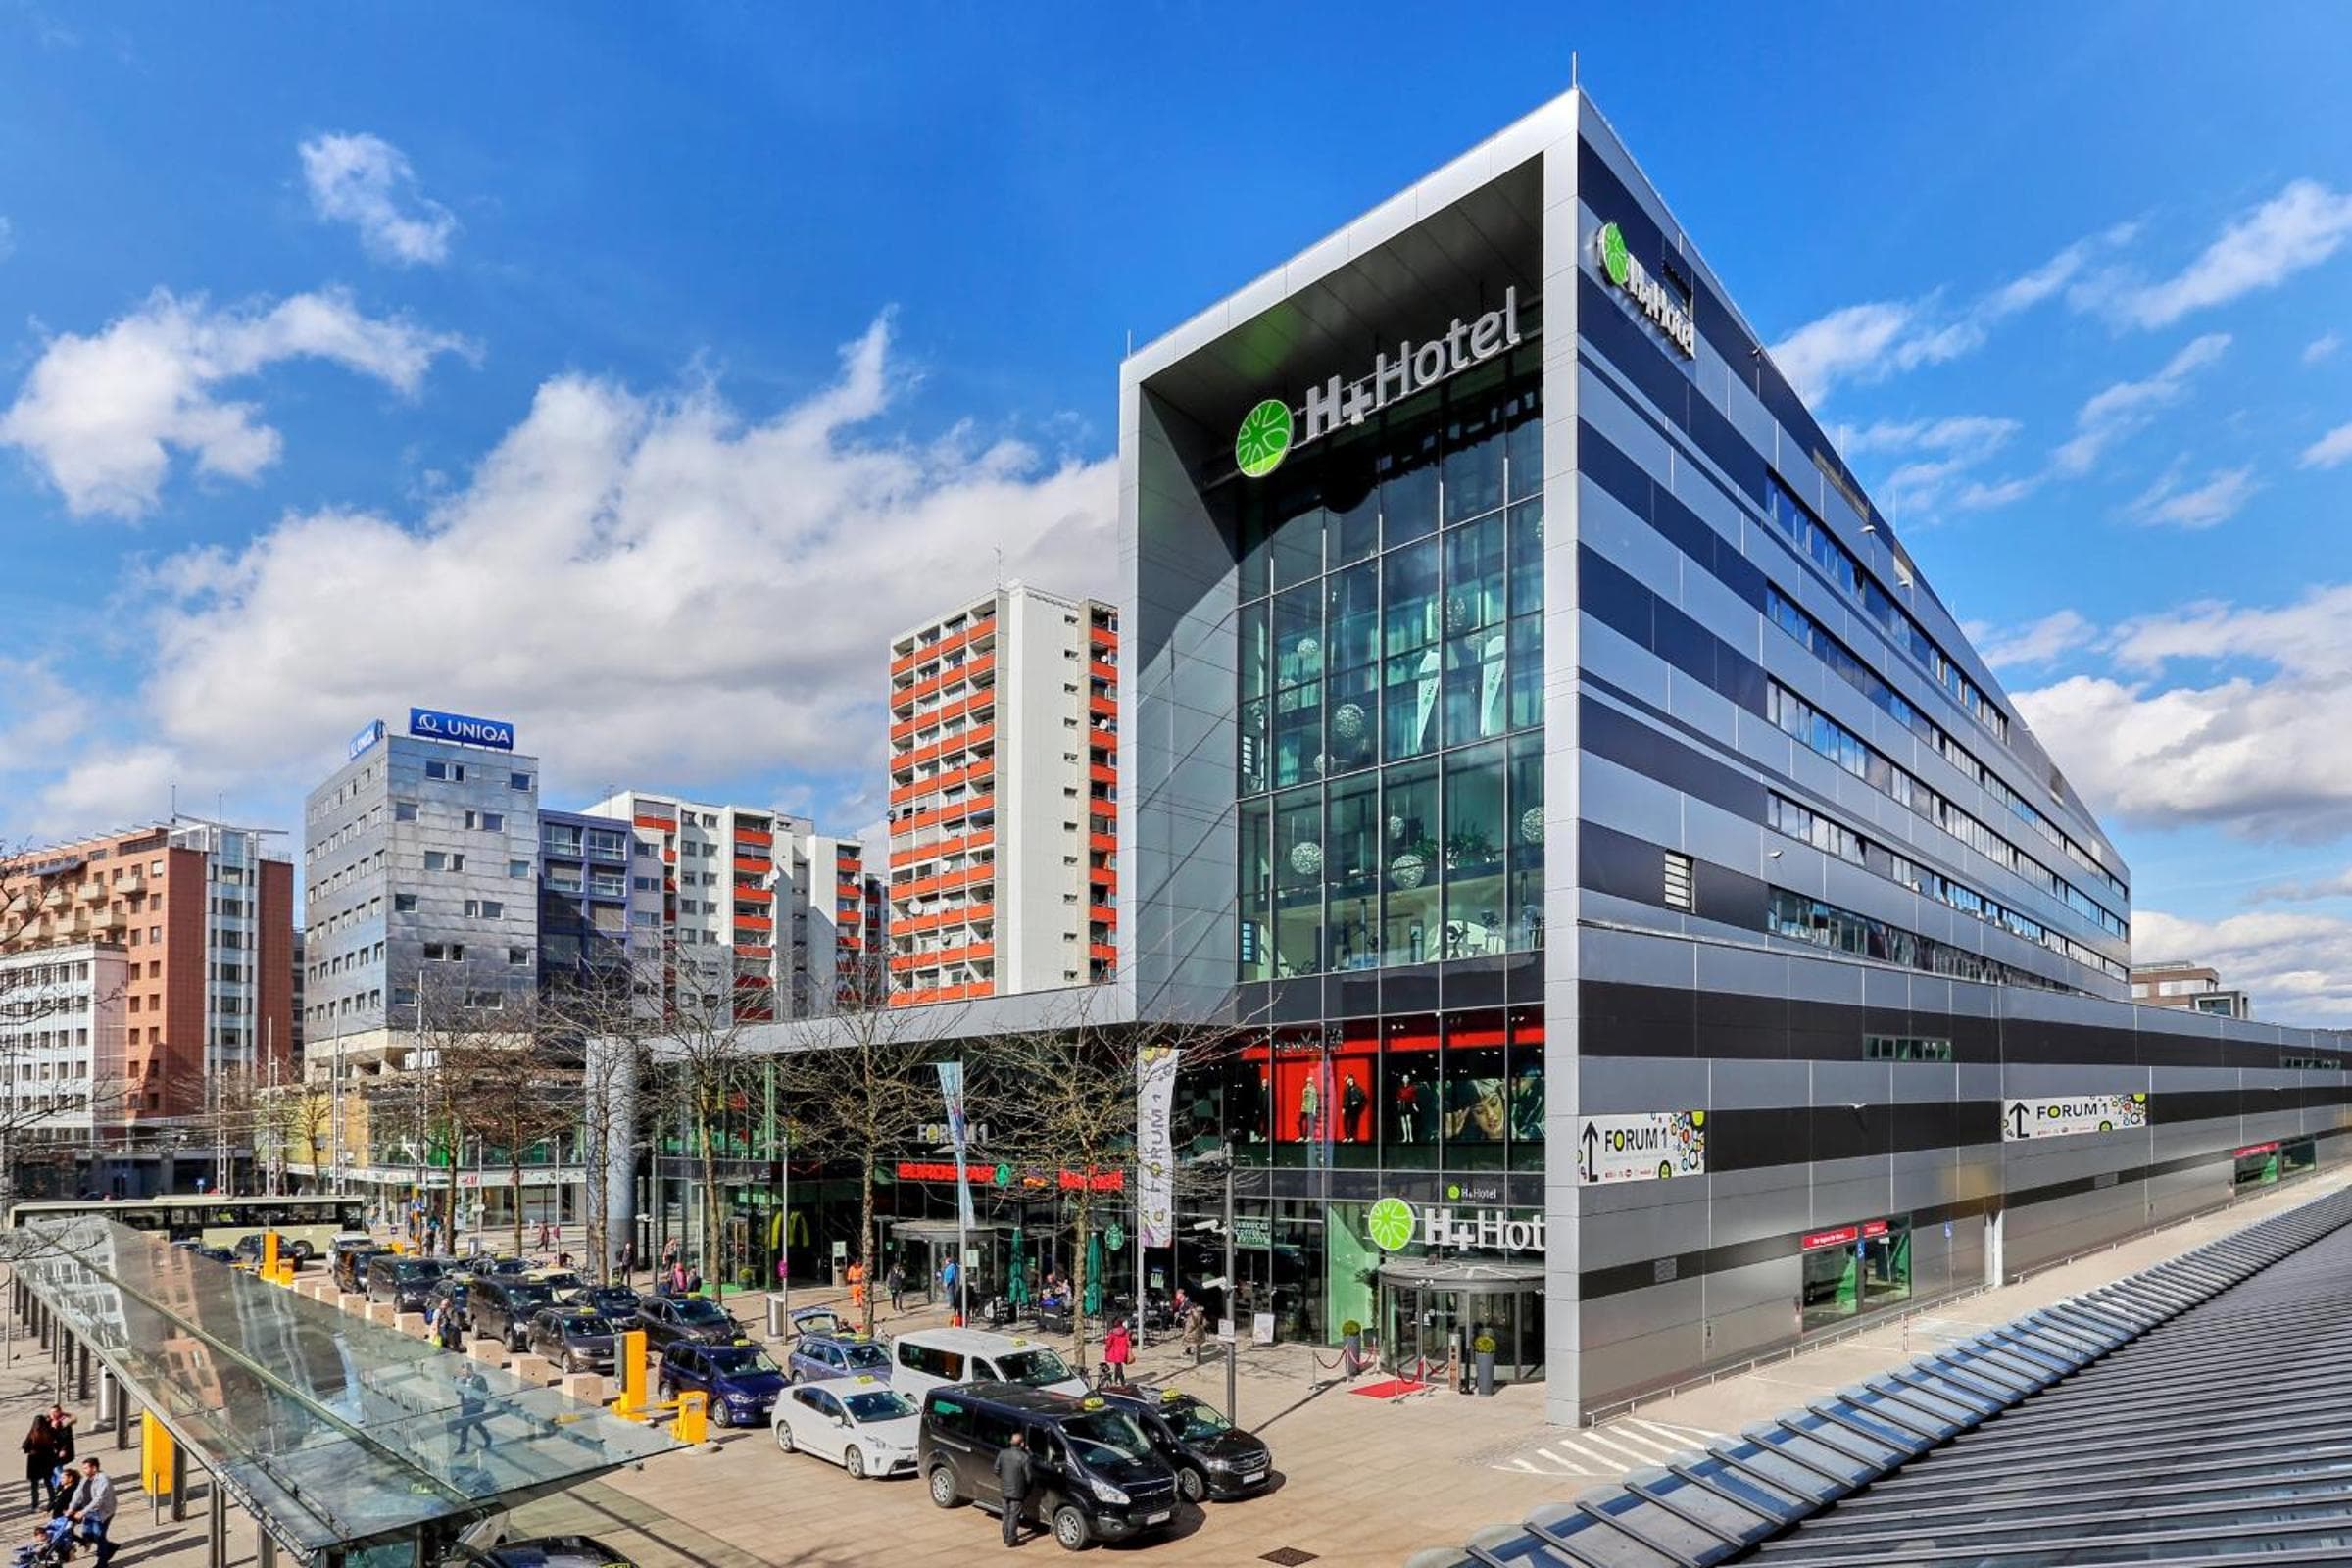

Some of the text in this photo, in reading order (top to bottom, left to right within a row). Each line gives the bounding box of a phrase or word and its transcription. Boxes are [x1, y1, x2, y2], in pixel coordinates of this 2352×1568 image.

[1306, 285, 1521, 441] H+Hotel
[447, 719, 510, 743] UNIQA
[2037, 1102, 2108, 1119] FORUM 1
[917, 1123, 977, 1144] FORM
[1605, 1127, 1668, 1152] FORUM 1
[898, 1162, 995, 1182] EUROSAR
[1425, 1208, 1545, 1251] H+Hot
